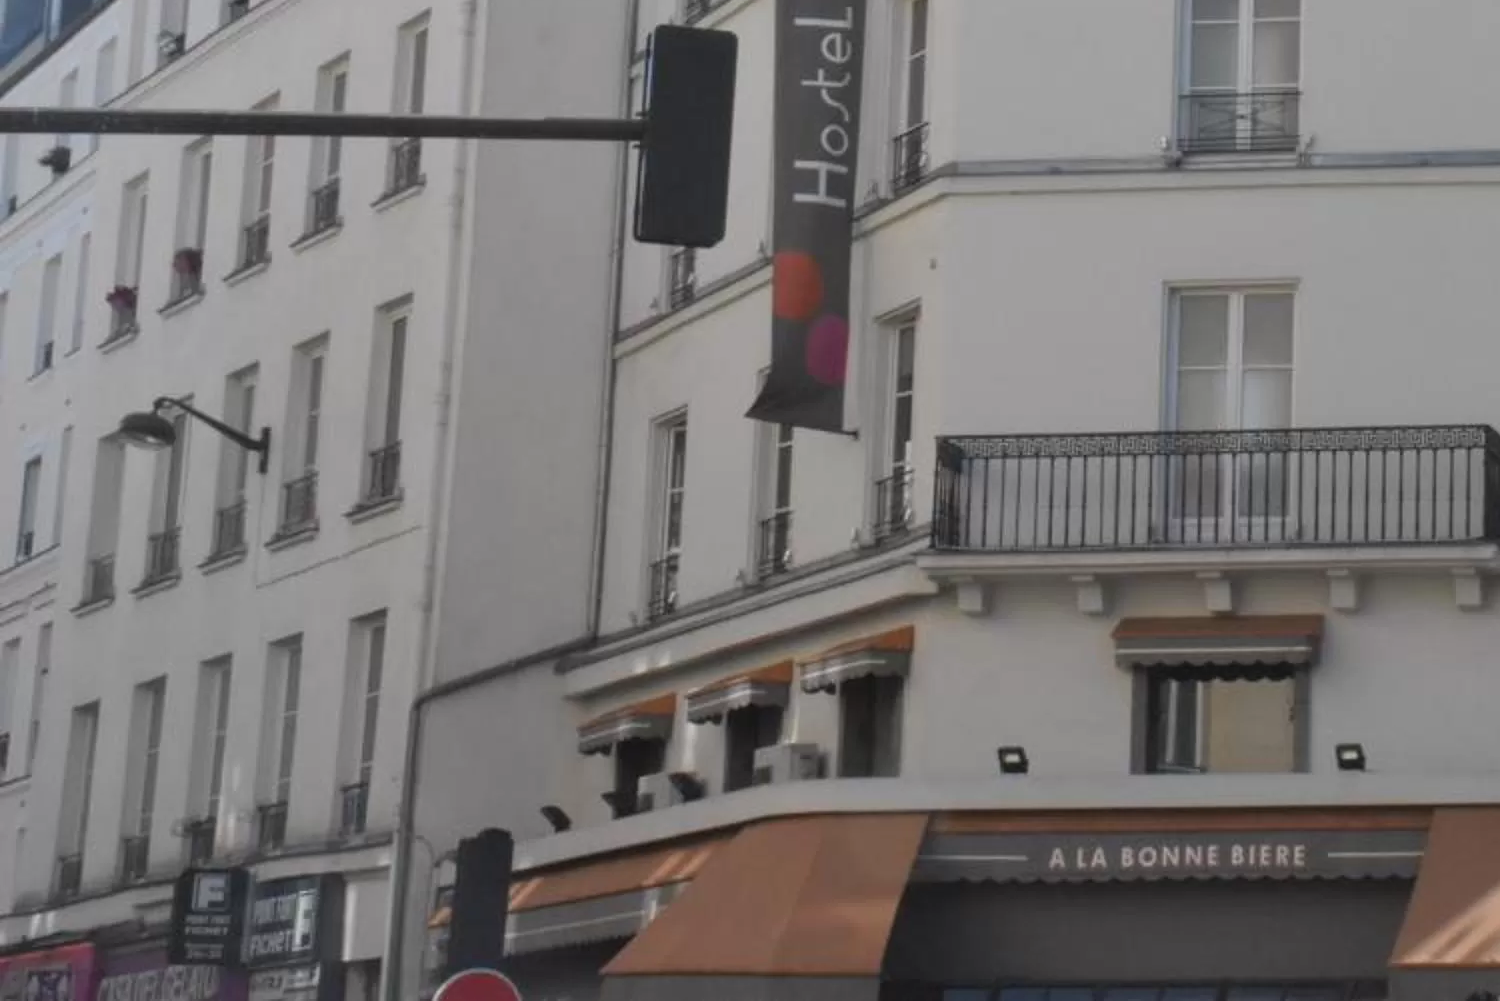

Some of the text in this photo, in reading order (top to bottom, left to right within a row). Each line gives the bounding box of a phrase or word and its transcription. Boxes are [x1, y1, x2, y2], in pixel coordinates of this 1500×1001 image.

[1049, 843, 1307, 869] A LA BONNE BIERE
